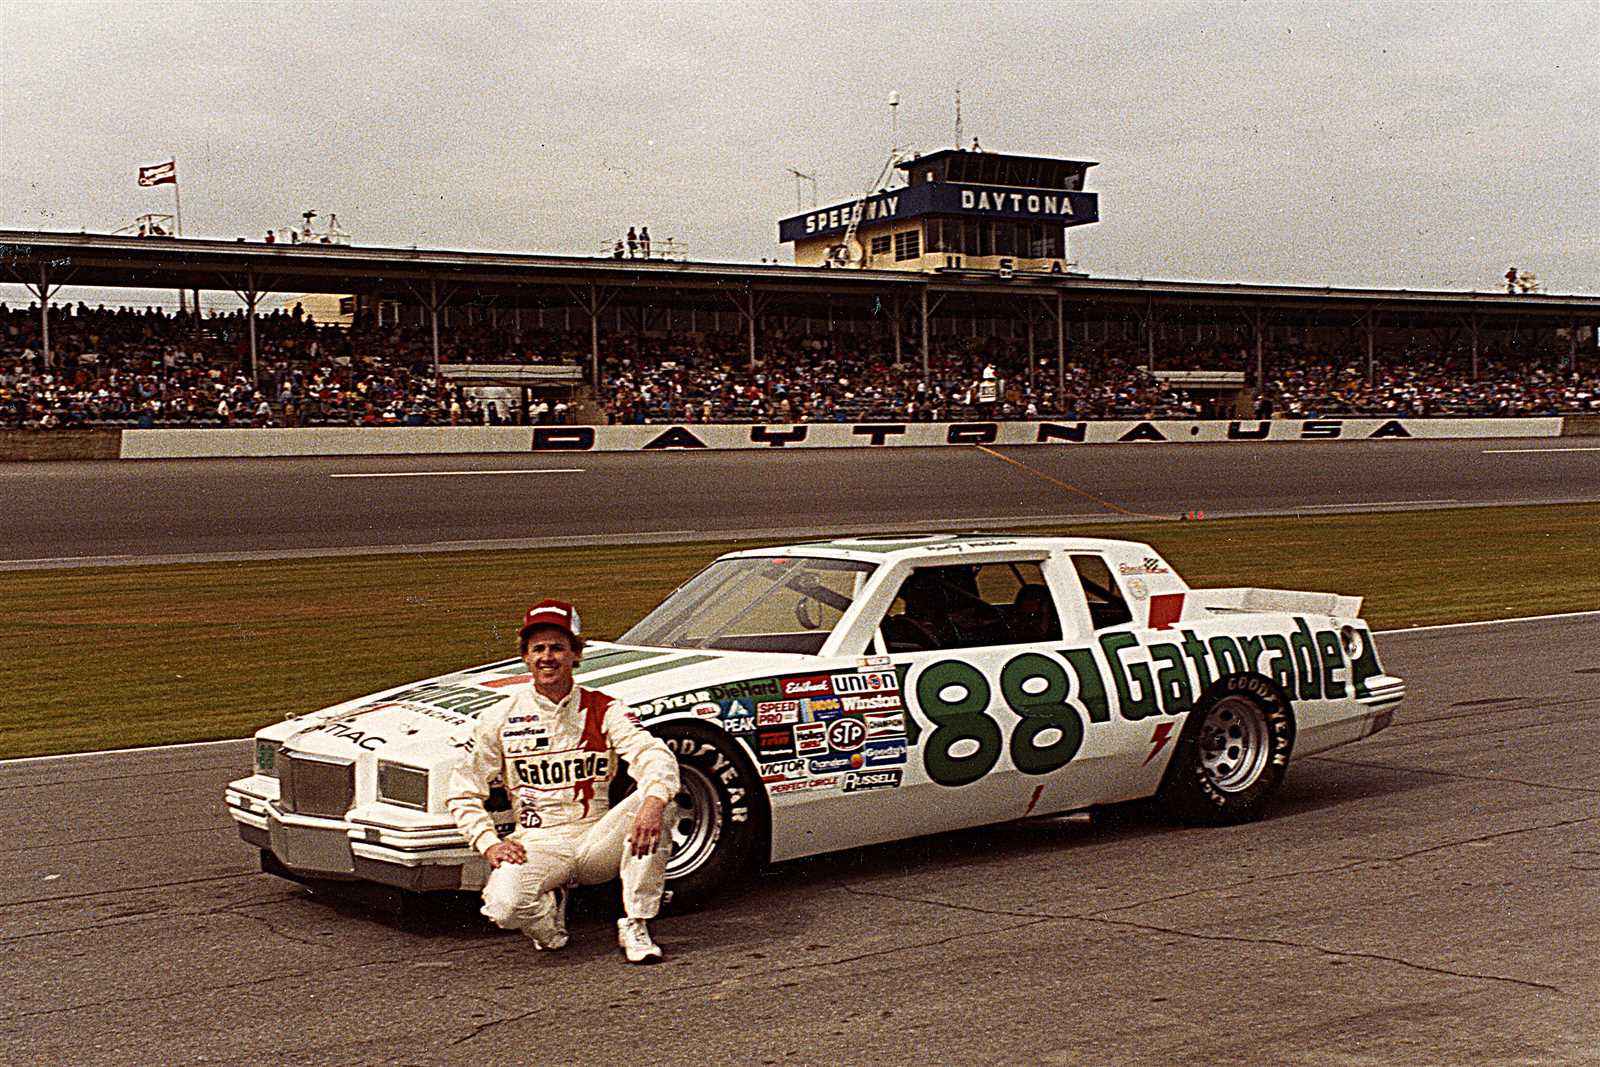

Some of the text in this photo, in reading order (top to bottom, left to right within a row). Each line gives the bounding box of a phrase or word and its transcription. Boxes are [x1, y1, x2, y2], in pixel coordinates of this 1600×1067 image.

[805, 196, 899, 233] SPEEDWAY
[961, 190, 1074, 215] DAYTONA
[532, 419, 1412, 452] DAYTONA USA
[1099, 617, 1348, 722] Gatorade
[712, 679, 778, 698] DieHard
[631, 690, 711, 716] ODYEAR
[760, 702, 796, 714] SPEED
[841, 695, 901, 711] Winston
[724, 716, 757, 732] PEAK
[759, 713, 783, 725] PRO
[915, 653, 1085, 788] 88
[1227, 677, 1289, 765] GOODYEAR
[833, 721, 863, 744] STP
[515, 753, 609, 785] Gatorade
[760, 759, 805, 775] VICTOR
[665, 739, 749, 823] ODYEAR
[770, 776, 840, 793] PERFECT CIRCLE
[520, 811, 541, 827] STP
